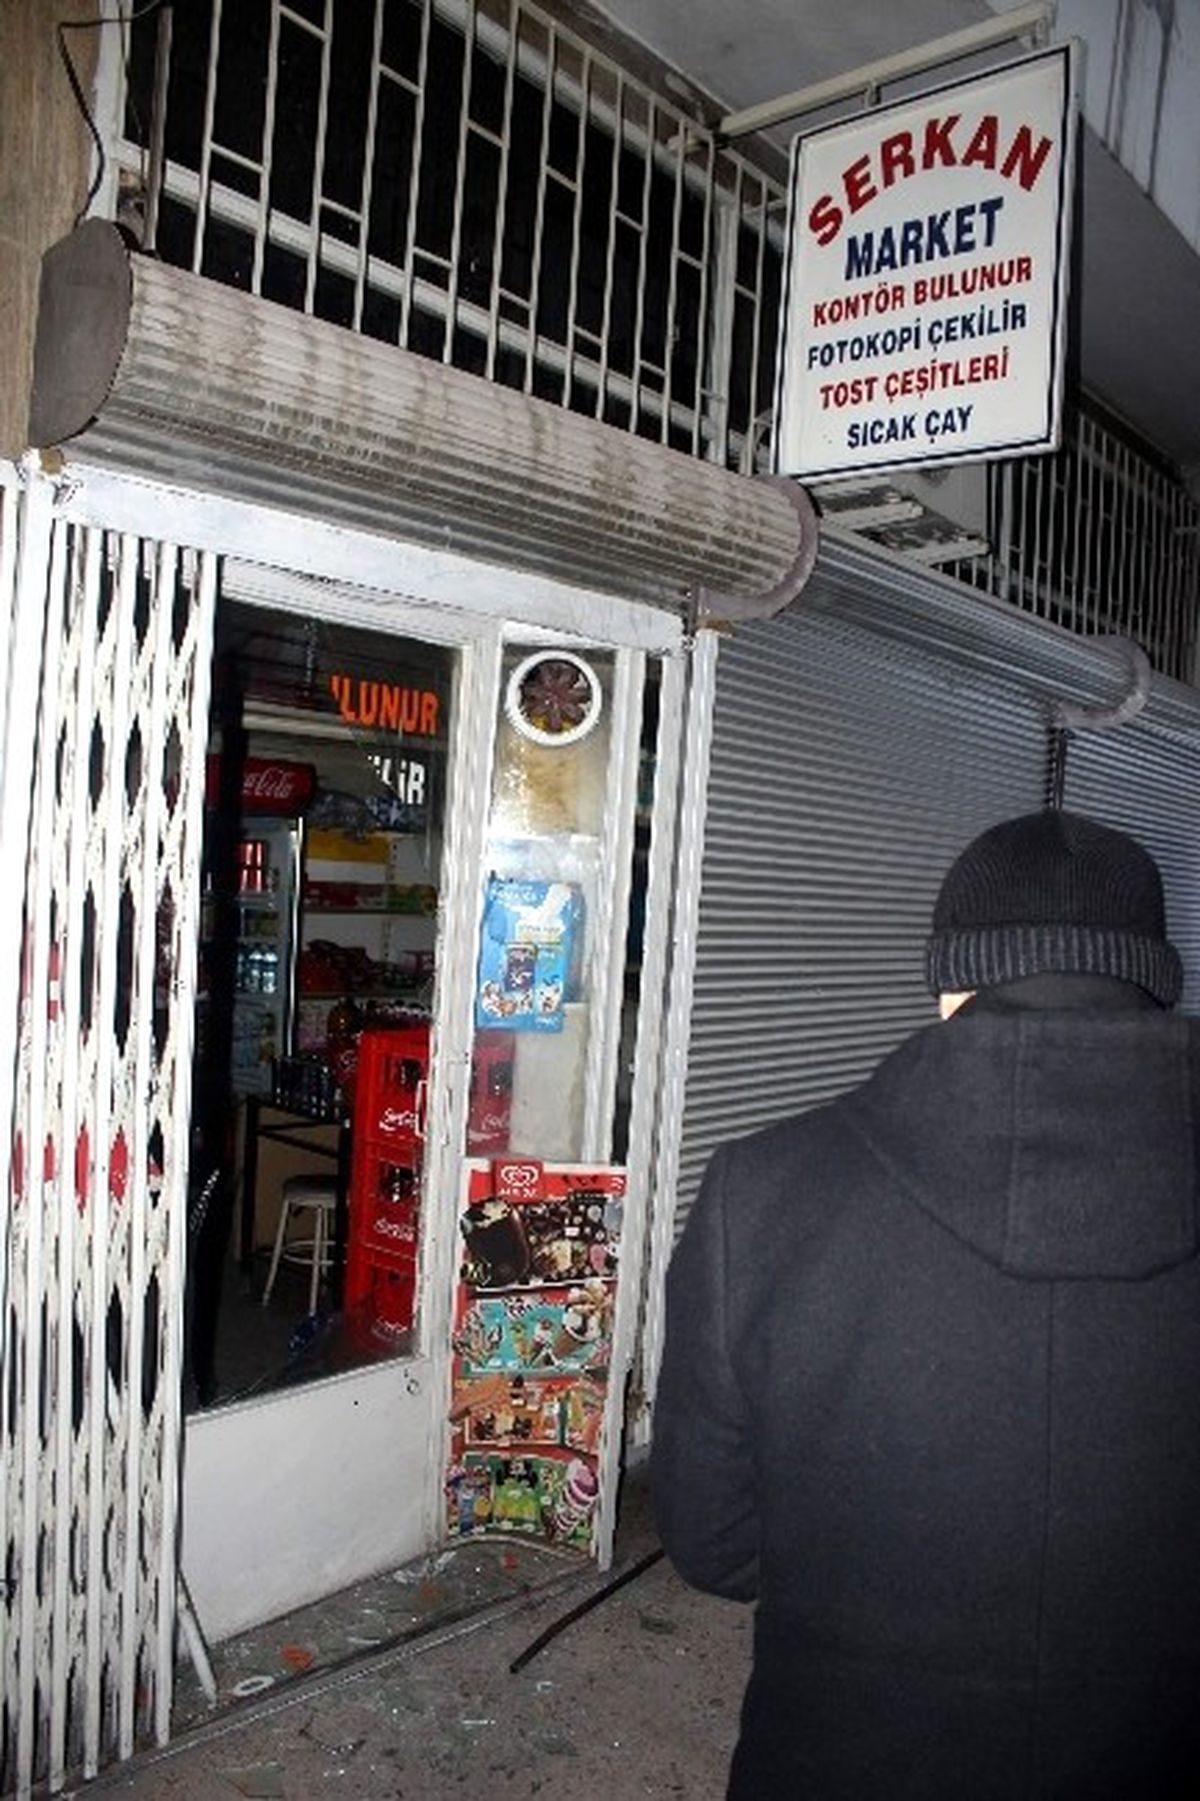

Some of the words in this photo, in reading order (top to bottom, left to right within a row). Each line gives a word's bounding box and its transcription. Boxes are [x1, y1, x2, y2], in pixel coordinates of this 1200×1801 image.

[808, 113, 1053, 247] SERKAN
[844, 197, 1004, 281] MARKET
[813, 282, 905, 327] KONTÖR
[914, 257, 1032, 305] BULUNUR
[808, 317, 921, 370] FOTOKOPİ
[927, 299, 1027, 352] ÇEKİLİR
[820, 376, 878, 410] TOST
[885, 346, 1010, 404] ÇEŞİTLERİ
[847, 415, 917, 449] SICAK
[925, 405, 973, 444] ÇAY
[367, 755, 426, 805] LİR
